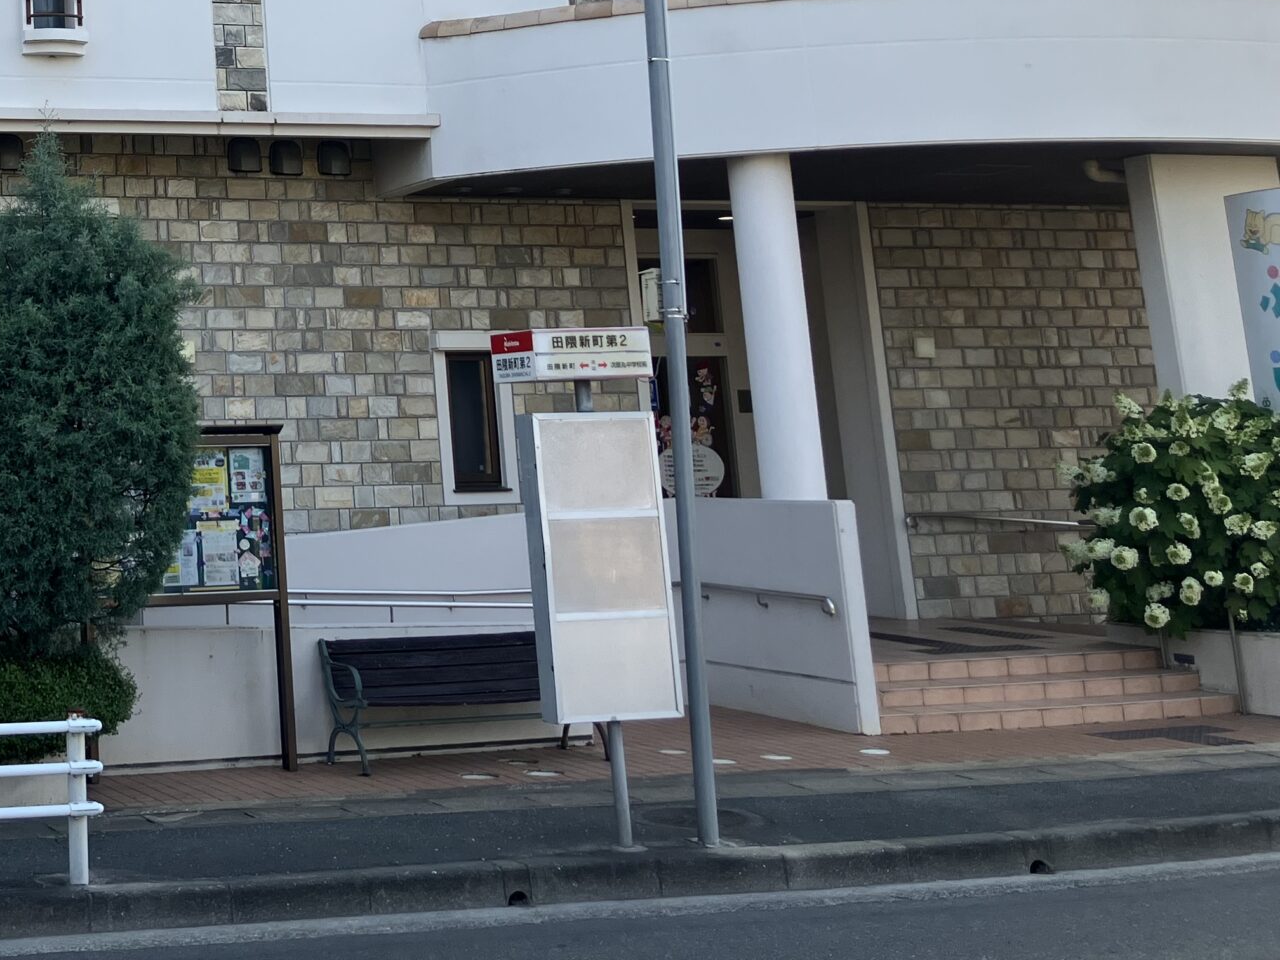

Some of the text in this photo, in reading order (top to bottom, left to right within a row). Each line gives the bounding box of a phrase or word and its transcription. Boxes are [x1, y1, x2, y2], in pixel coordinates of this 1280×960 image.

[551, 334, 628, 349] 田隈新町第2
[496, 356, 531, 371] 田隈新町第2
